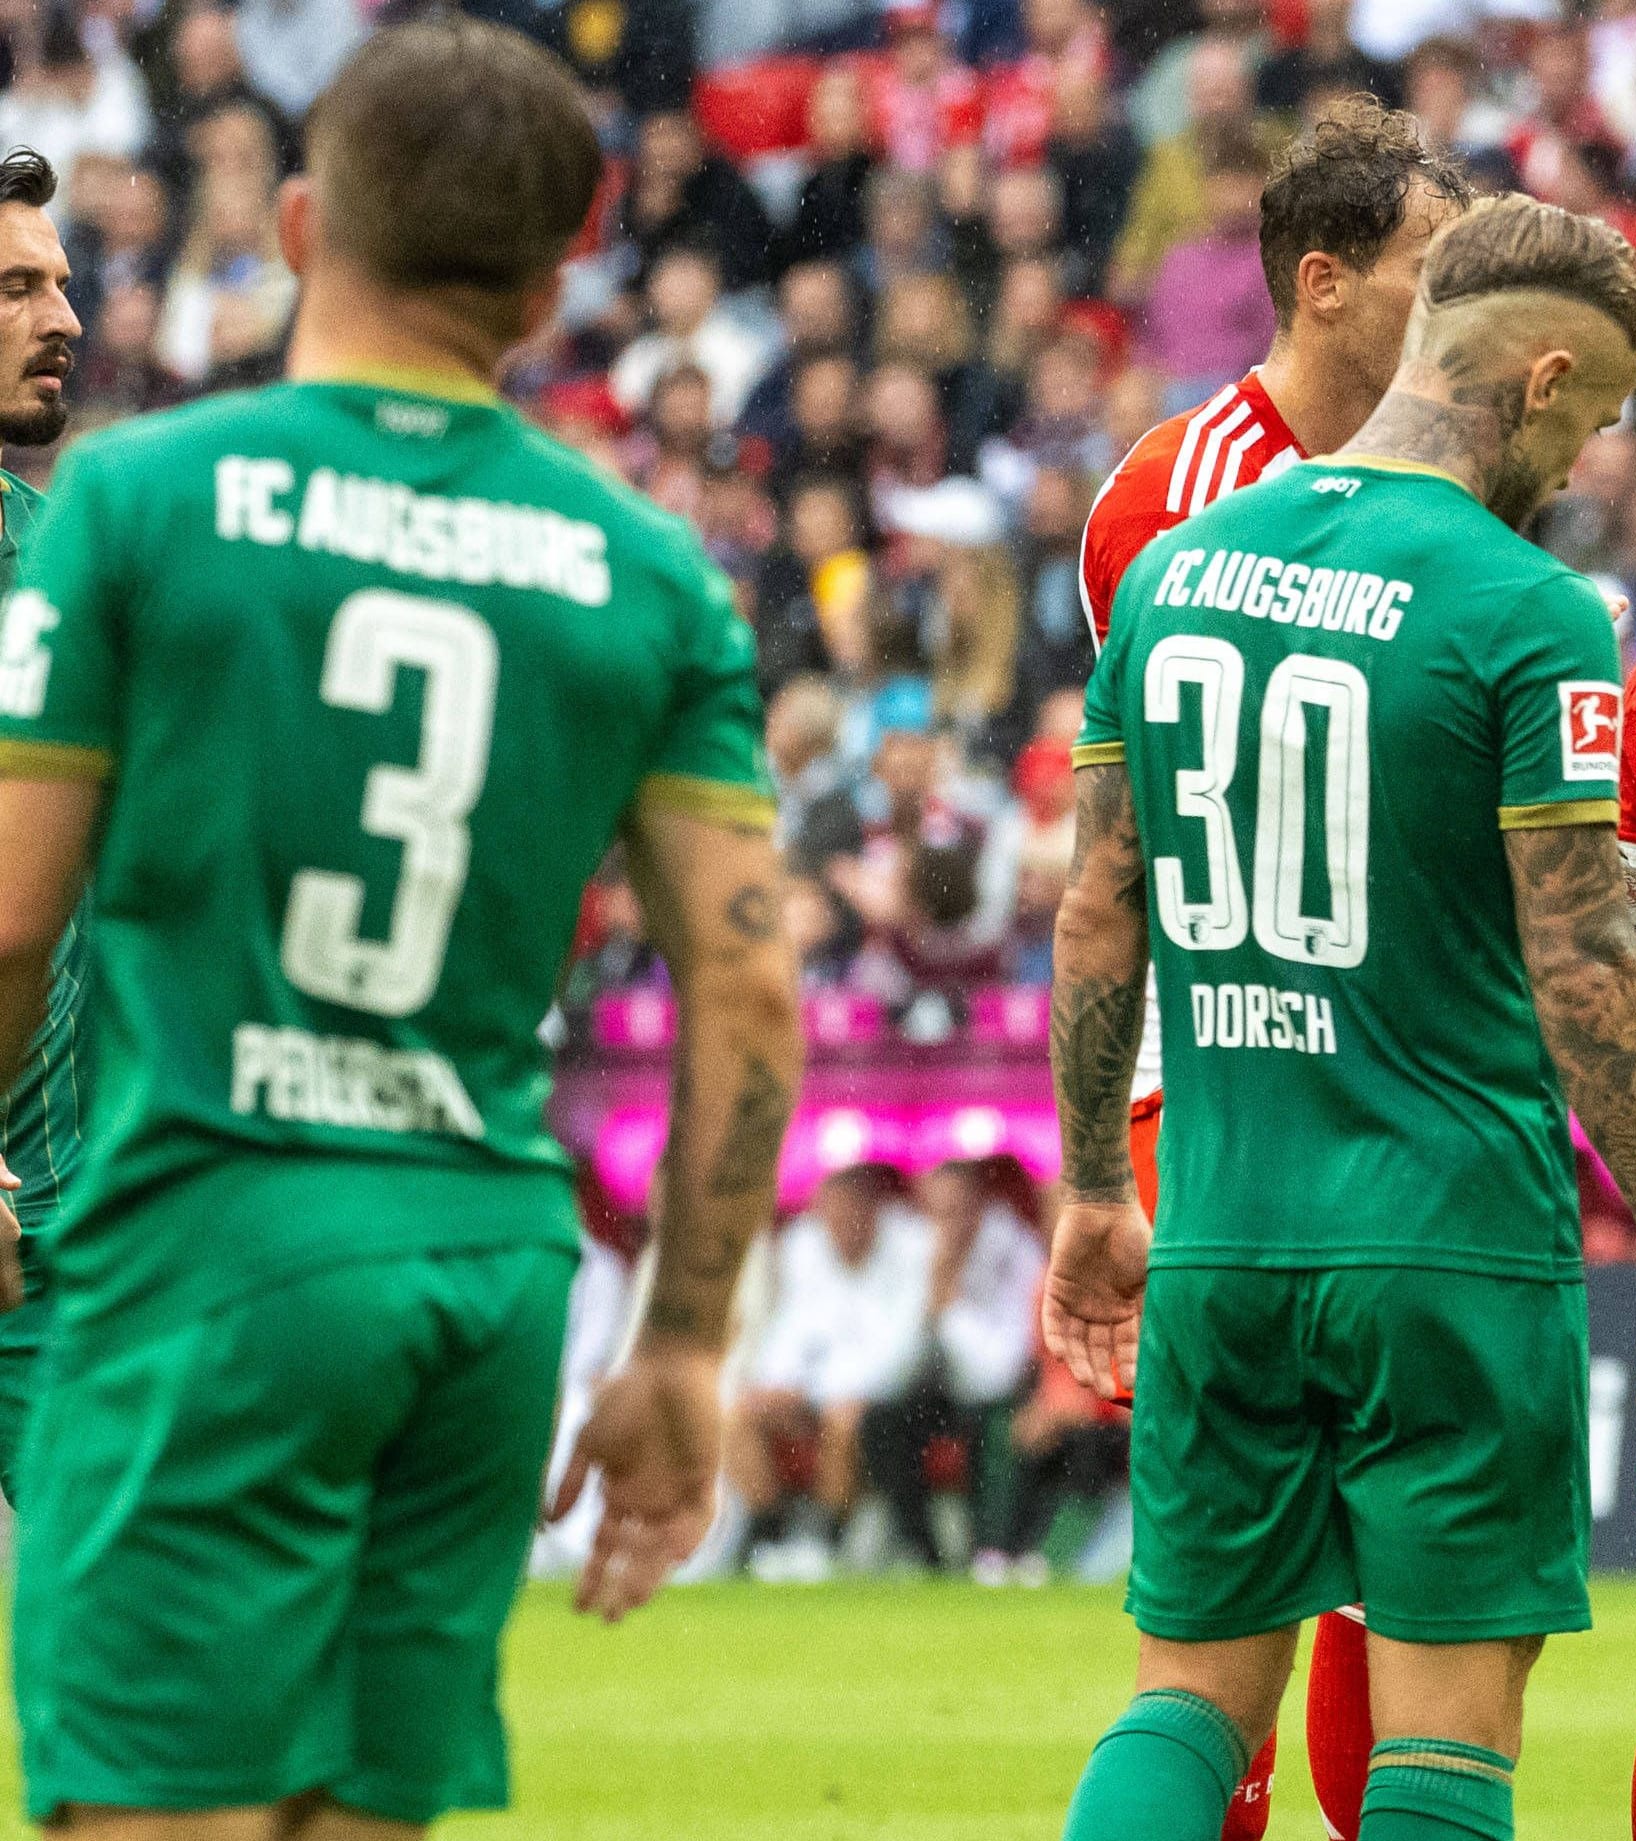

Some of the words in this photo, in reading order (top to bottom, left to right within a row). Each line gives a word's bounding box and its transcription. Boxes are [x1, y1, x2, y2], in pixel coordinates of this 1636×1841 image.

[213, 454, 296, 547] FC
[296, 464, 612, 608] AUGSBURG
[1153, 548, 1206, 607] FC
[1190, 548, 1414, 642] AUGSBURG
[280, 587, 500, 1018] 3
[1145, 635, 1370, 969] 30
[1190, 983, 1337, 1055] DORSCH
